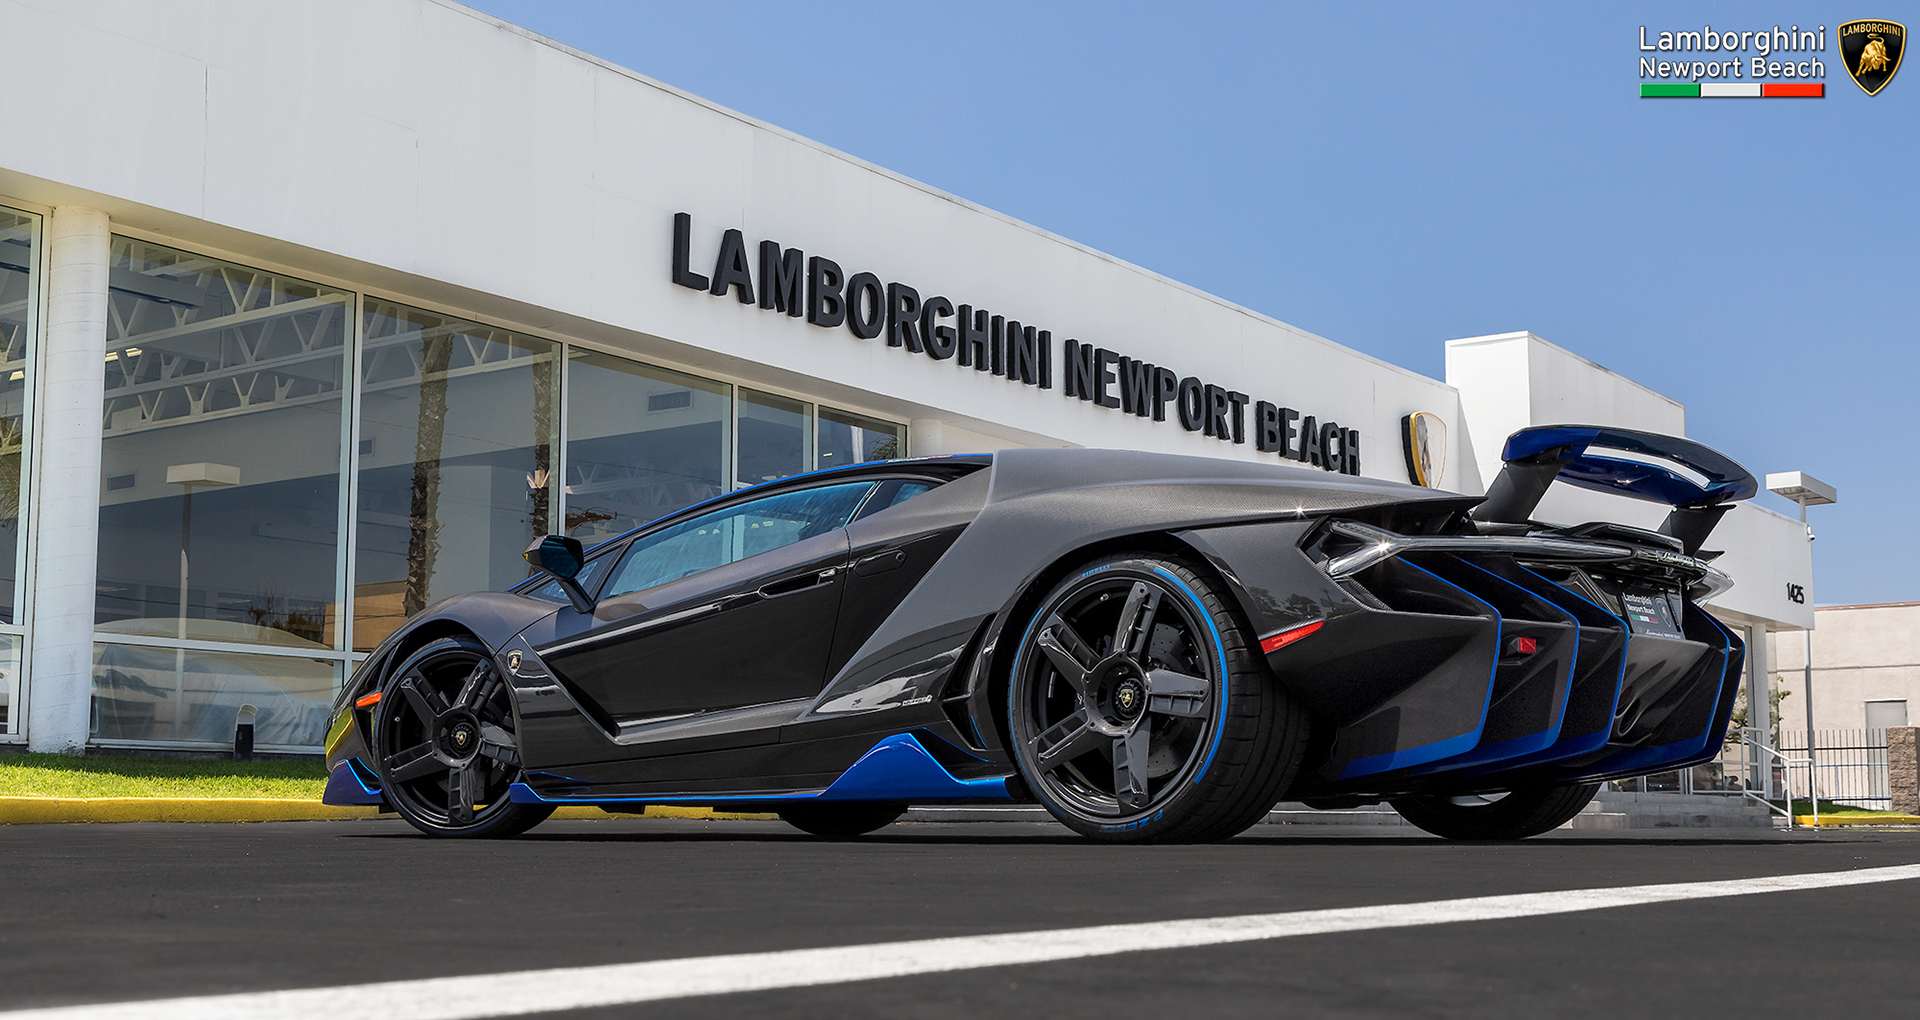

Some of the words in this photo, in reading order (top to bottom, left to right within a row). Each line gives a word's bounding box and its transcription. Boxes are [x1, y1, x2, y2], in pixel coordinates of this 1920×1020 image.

[672, 212, 1052, 389] LAMBORGHINI
[1064, 338, 1250, 444] NEWPORT
[1256, 399, 1361, 476] BEACH
[1786, 582, 1805, 605] 1425
